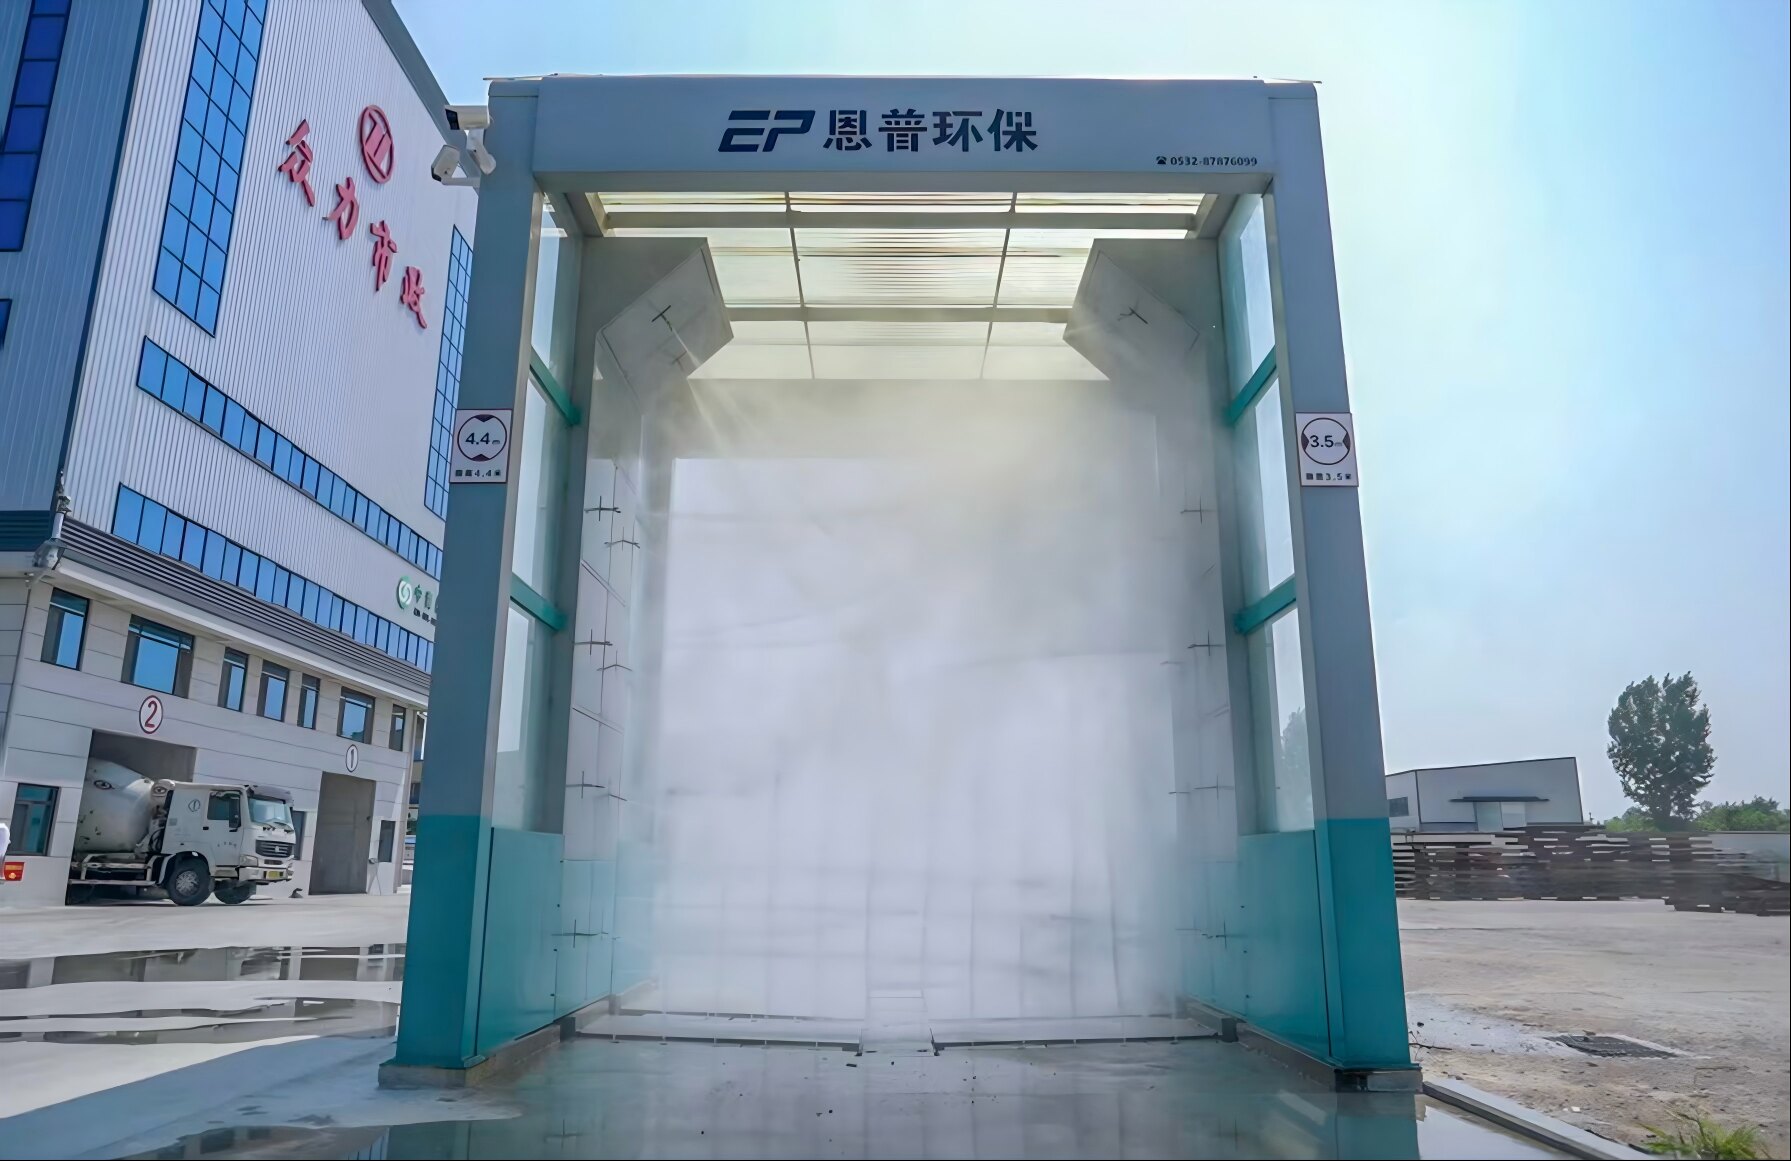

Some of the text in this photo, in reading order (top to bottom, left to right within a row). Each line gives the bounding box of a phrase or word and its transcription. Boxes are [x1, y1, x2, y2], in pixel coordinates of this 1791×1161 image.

[718, 110, 816, 152] EP
[822, 108, 1039, 152] 恩普环保
[1170, 156, 1258, 167] 0532-87876099
